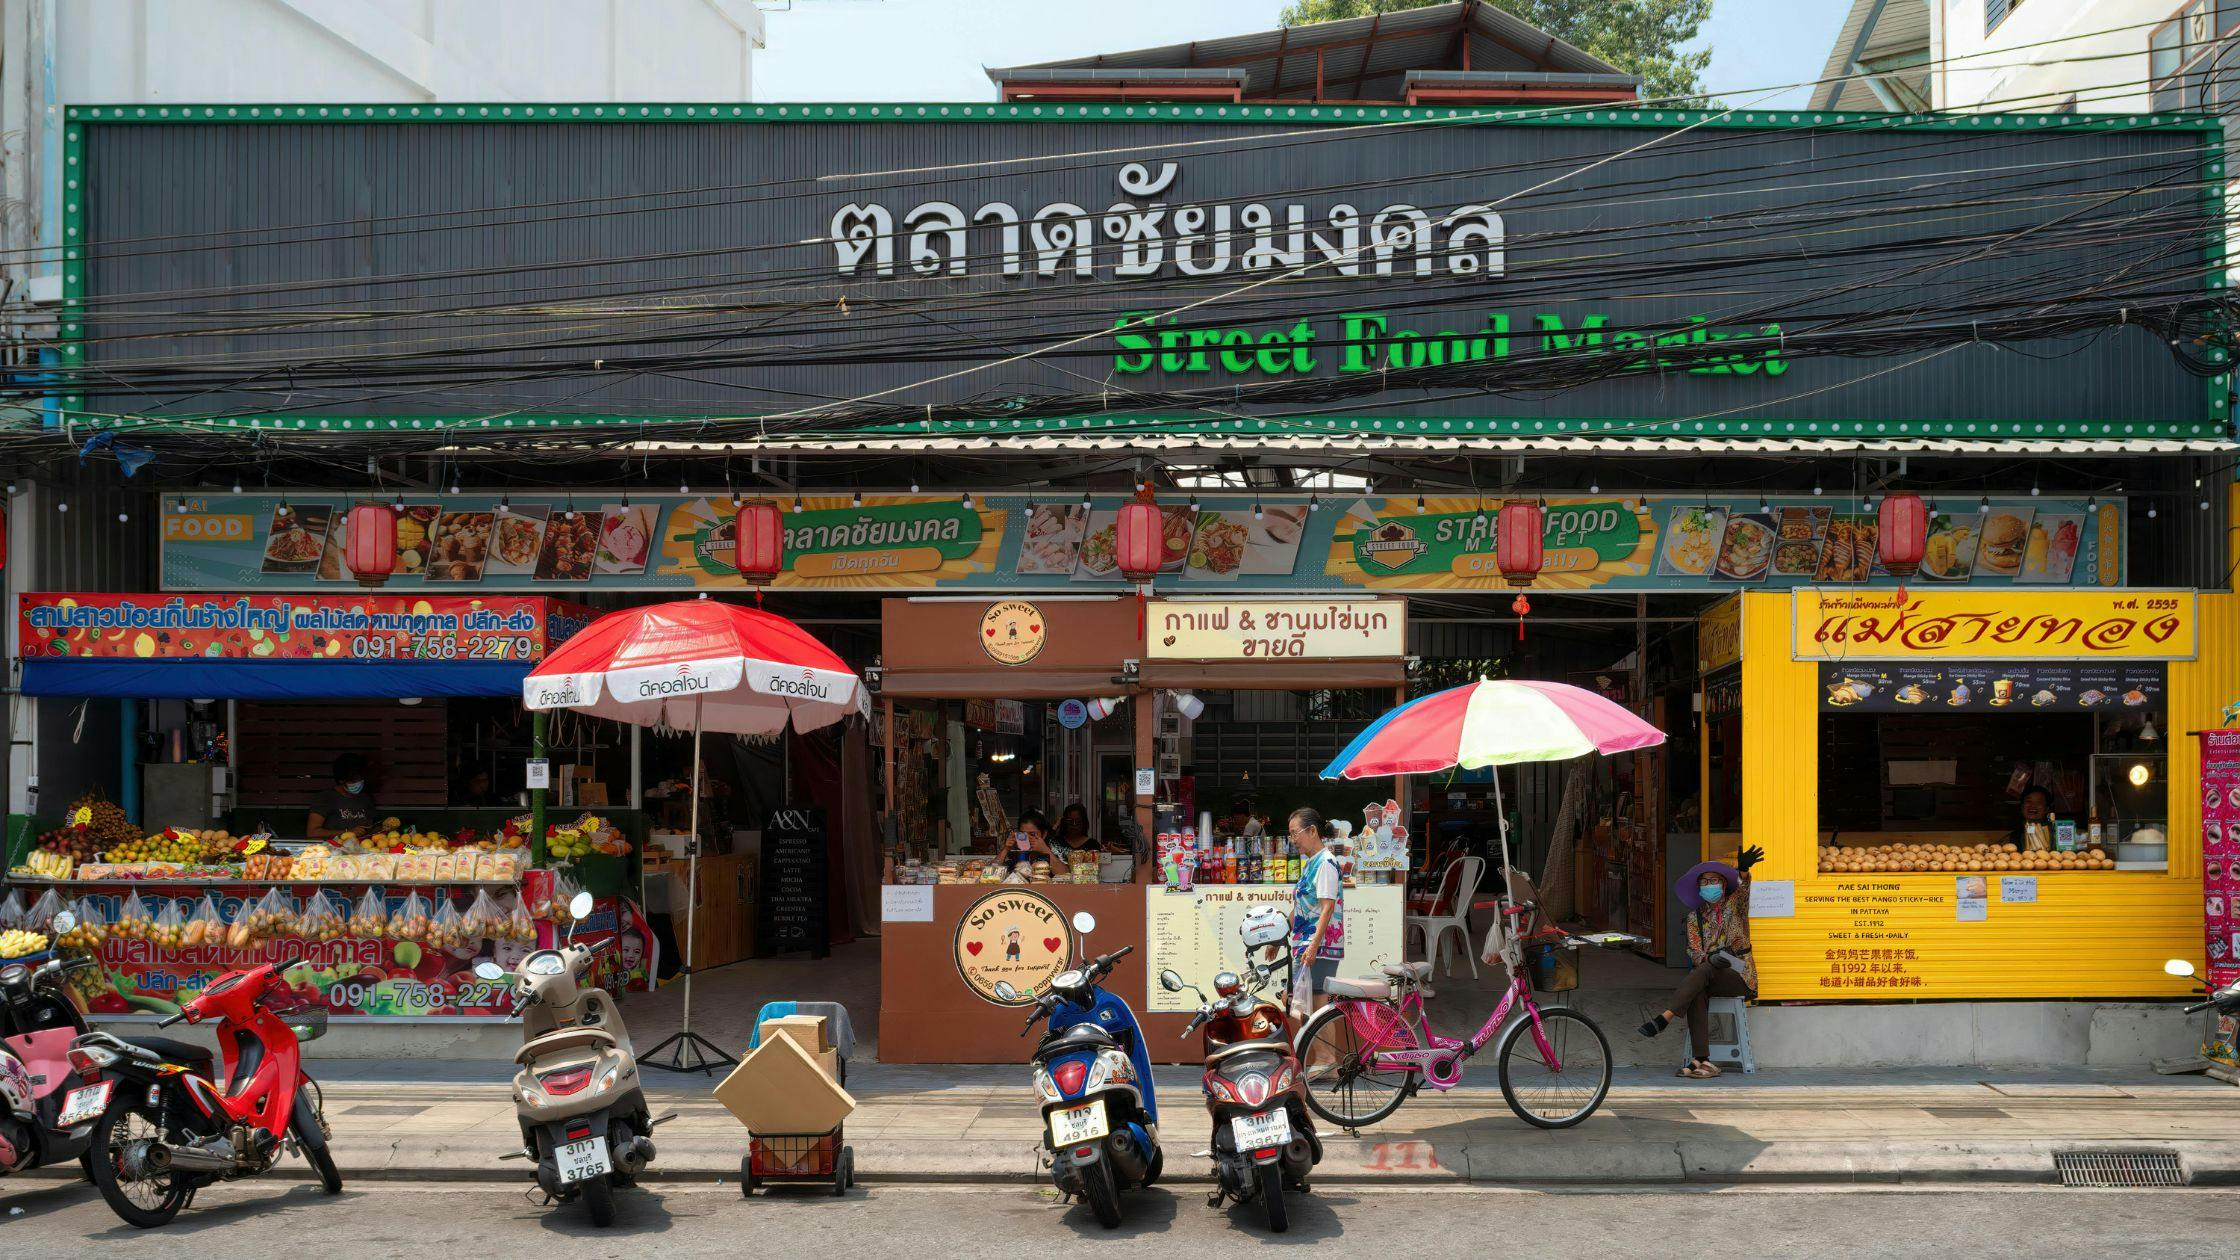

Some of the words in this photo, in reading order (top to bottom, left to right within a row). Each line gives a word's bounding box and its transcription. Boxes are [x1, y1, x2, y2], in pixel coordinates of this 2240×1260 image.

[830, 162, 1505, 279] ตลาดชัยมงคล
[1112, 311, 1319, 375] Street
[1338, 312, 1511, 373] Food
[166, 500, 207, 512] TAI
[167, 518, 242, 536] FOOD
[1436, 518, 1498, 542] STRE
[1545, 509, 1619, 533] FOOD
[1371, 542, 1397, 550] STREET
[831, 554, 900, 573] เปิดทุกวัน
[1542, 555, 1579, 570] aily
[988, 609, 1002, 622] So
[1003, 603, 1036, 617] sweet
[1819, 596, 1902, 609] ร้านข้าวเหนียวมะม่วง
[2113, 599, 2139, 610] พ.ศ.
[2147, 599, 2178, 610] 2535
[30, 598, 291, 634] สามสาวน้อยถิ่นช้างใหญ่
[294, 608, 457, 635] ผลไม้สดตามฤดูกาล
[464, 610, 535, 631] ปลีก-ส่ง
[1165, 606, 1229, 631] กาแฟ
[1239, 610, 1256, 631] &
[1265, 605, 1387, 637] ชานมไข่มุก
[1814, 600, 2180, 650] แม่สายทอง
[352, 635, 531, 659] 091-758-2279
[1243, 632, 1306, 657] ขายดี
[1937, 673, 1942, 681] S
[768, 810, 810, 830] A&N
[1205, 891, 1233, 901] กาแฟ
[1236, 892, 1244, 902] &
[1247, 890, 1293, 905] ชานมไข่มุ
[970, 908, 995, 930] So
[997, 899, 1054, 925] sweet
[1014, 964, 1025, 972] for
[1063, 1126, 1099, 1142] 4916
[573, 1153, 593, 1165] ชลบุรี
[567, 1161, 604, 1180] 3765
